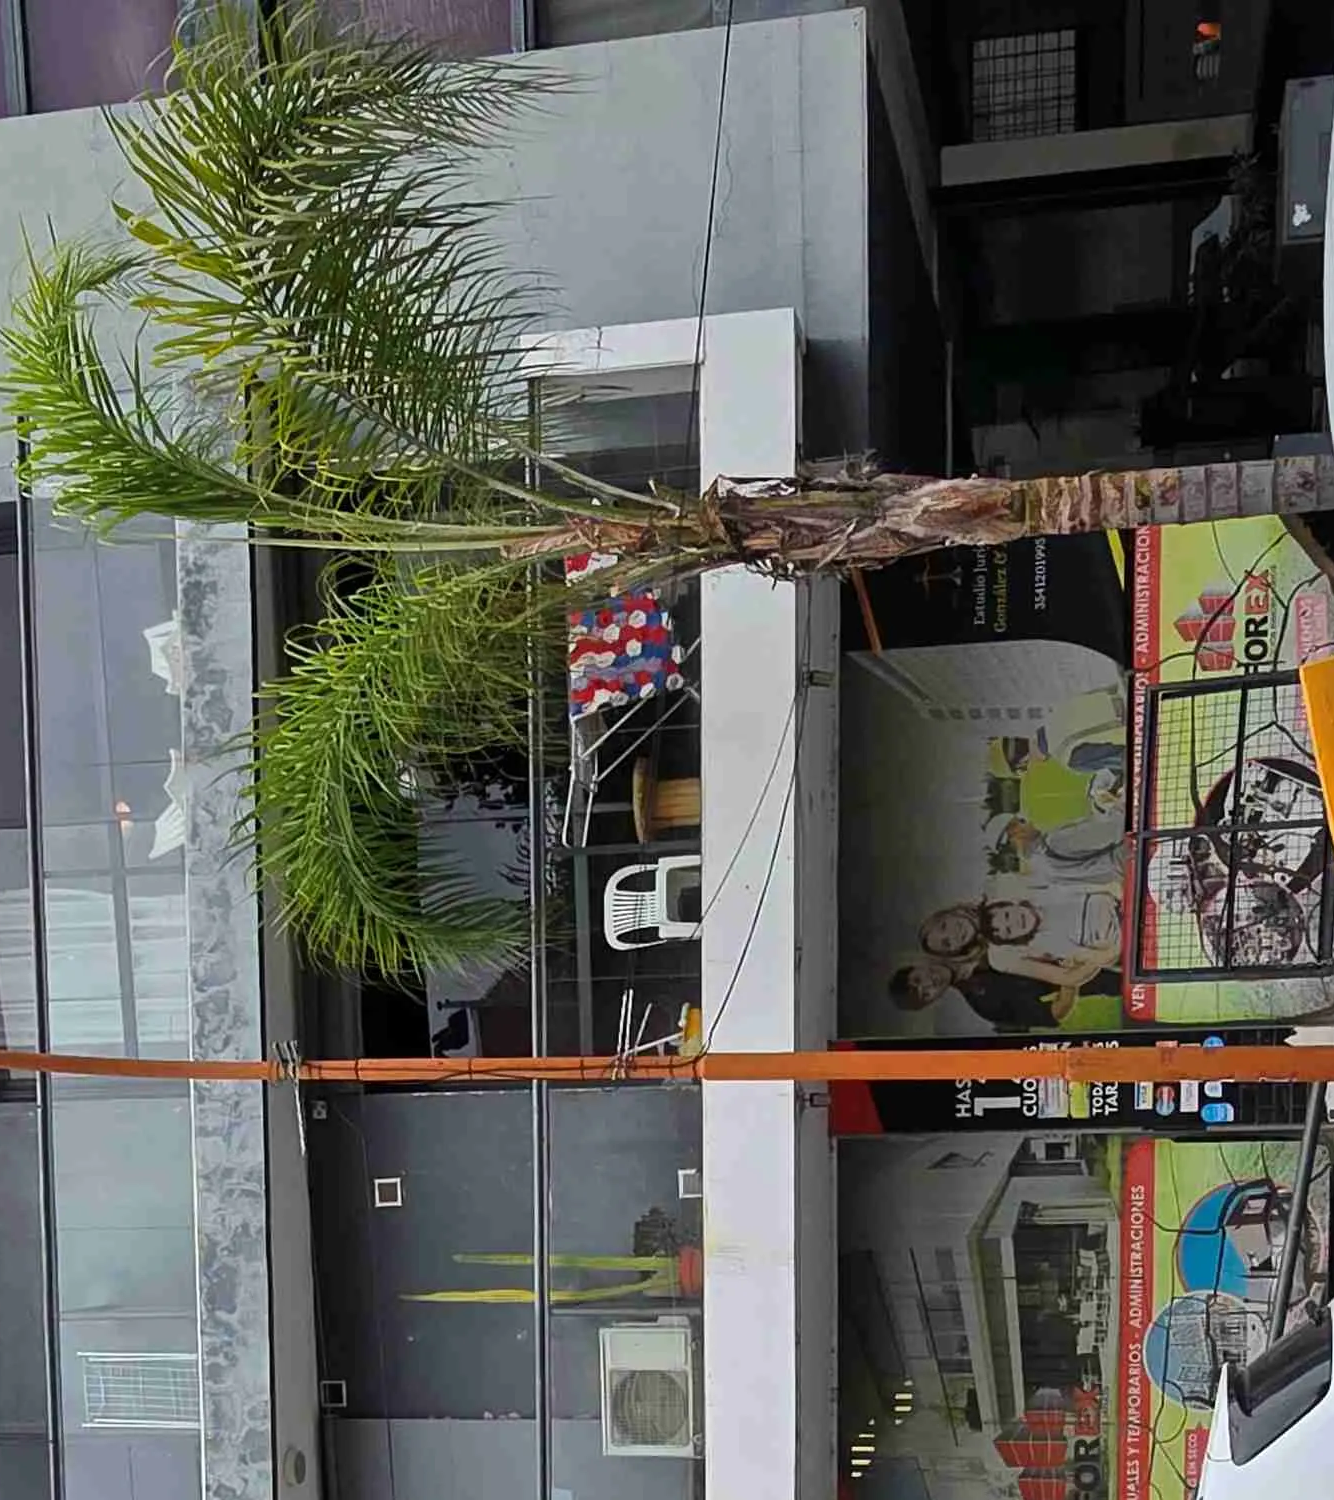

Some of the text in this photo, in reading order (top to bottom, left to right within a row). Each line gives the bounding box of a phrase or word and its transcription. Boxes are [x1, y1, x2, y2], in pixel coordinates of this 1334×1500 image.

[972, 575, 986, 625] Estudio
[992, 567, 1008, 633] González
[1134, 525, 1151, 654] ADMINISTRACION
[954, 1078, 972, 1118] HAS
[1022, 1045, 1038, 1117] CUOS
[1128, 1184, 1145, 1328] ADMINISTRACIONES
[1127, 1343, 1143, 1443] TEMPORARIOS
[1127, 1446, 1141, 1457] Y
